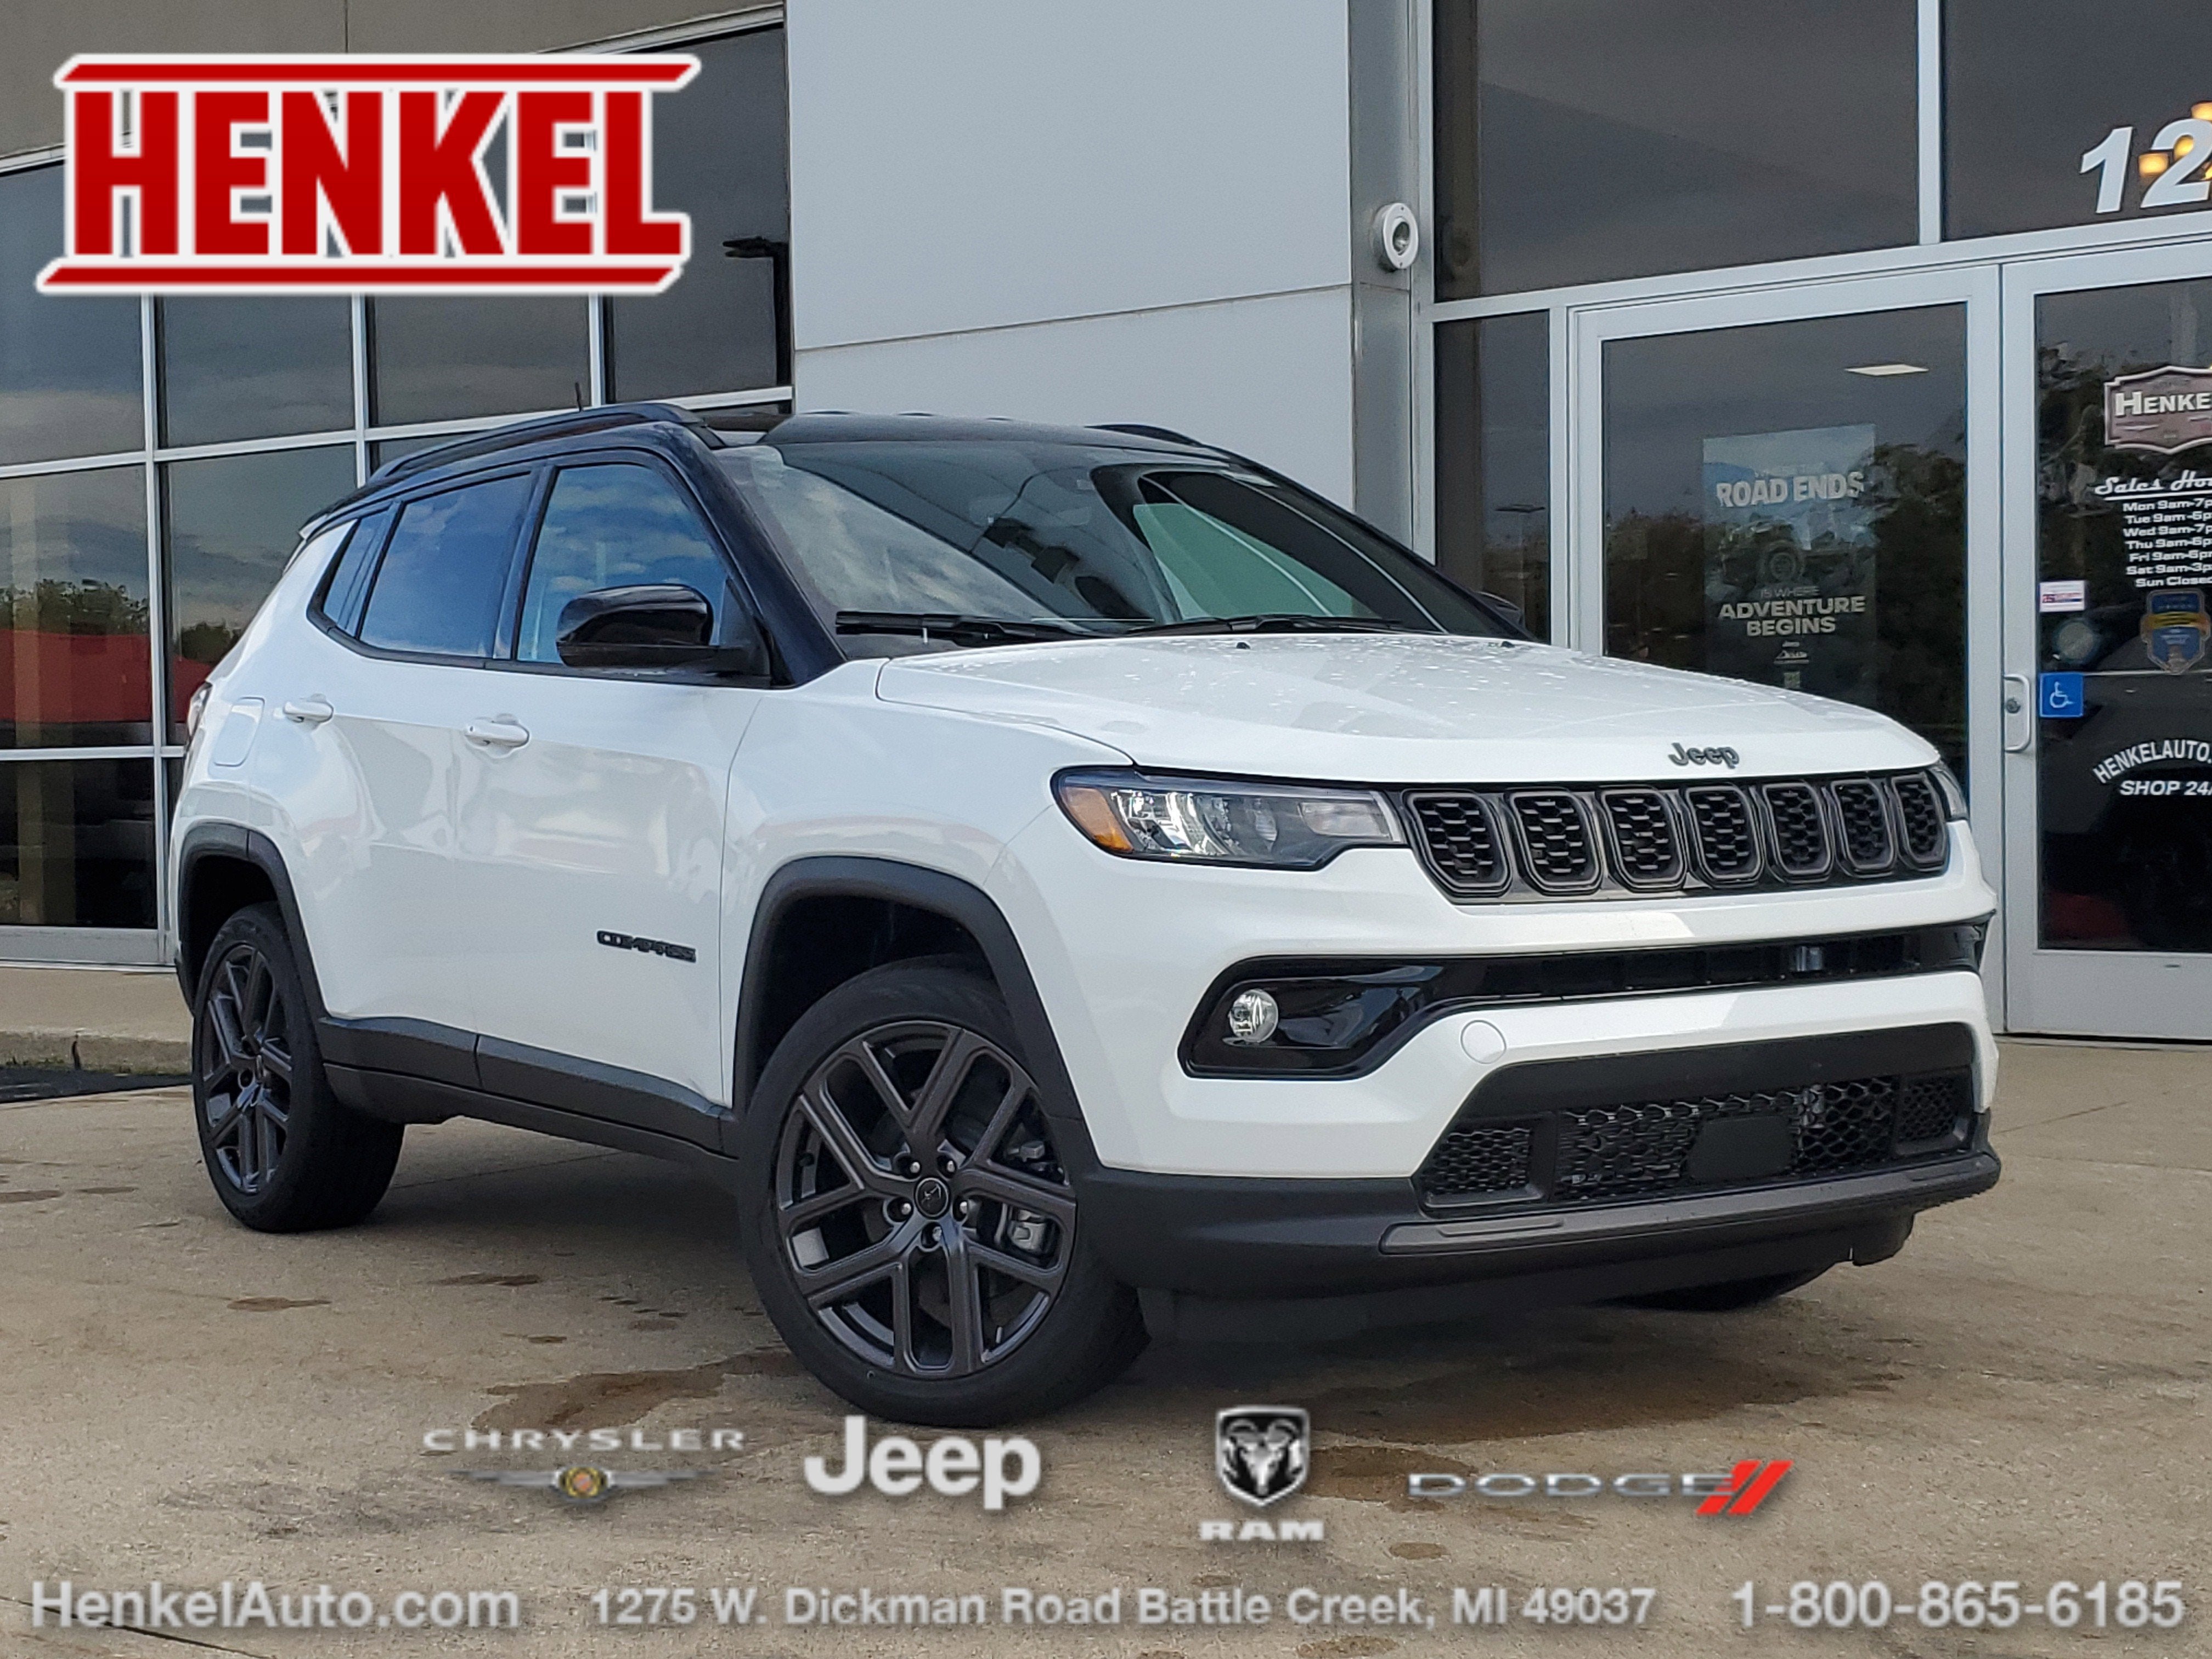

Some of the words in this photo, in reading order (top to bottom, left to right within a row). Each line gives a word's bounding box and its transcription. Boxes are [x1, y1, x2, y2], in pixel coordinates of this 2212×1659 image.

[2079, 117, 2212, 213] 12
[1716, 478, 1788, 507] ROAD
[1793, 471, 1865, 501] ENDS
[2095, 476, 2164, 495] Sales
[2123, 502, 2155, 512] Mon
[2123, 515, 2151, 524] Tue
[2123, 526, 2156, 537] Wed
[2124, 540, 2153, 550] Thu
[2129, 552, 2150, 562] Fri
[2126, 566, 2154, 575] Sat
[2135, 578, 2164, 587] Sun
[1718, 595, 1866, 619] ADVENTURE
[1746, 616, 1836, 636] BEGINS
[1668, 742, 1740, 769] Jeep
[2119, 780, 2181, 795] SHOP
